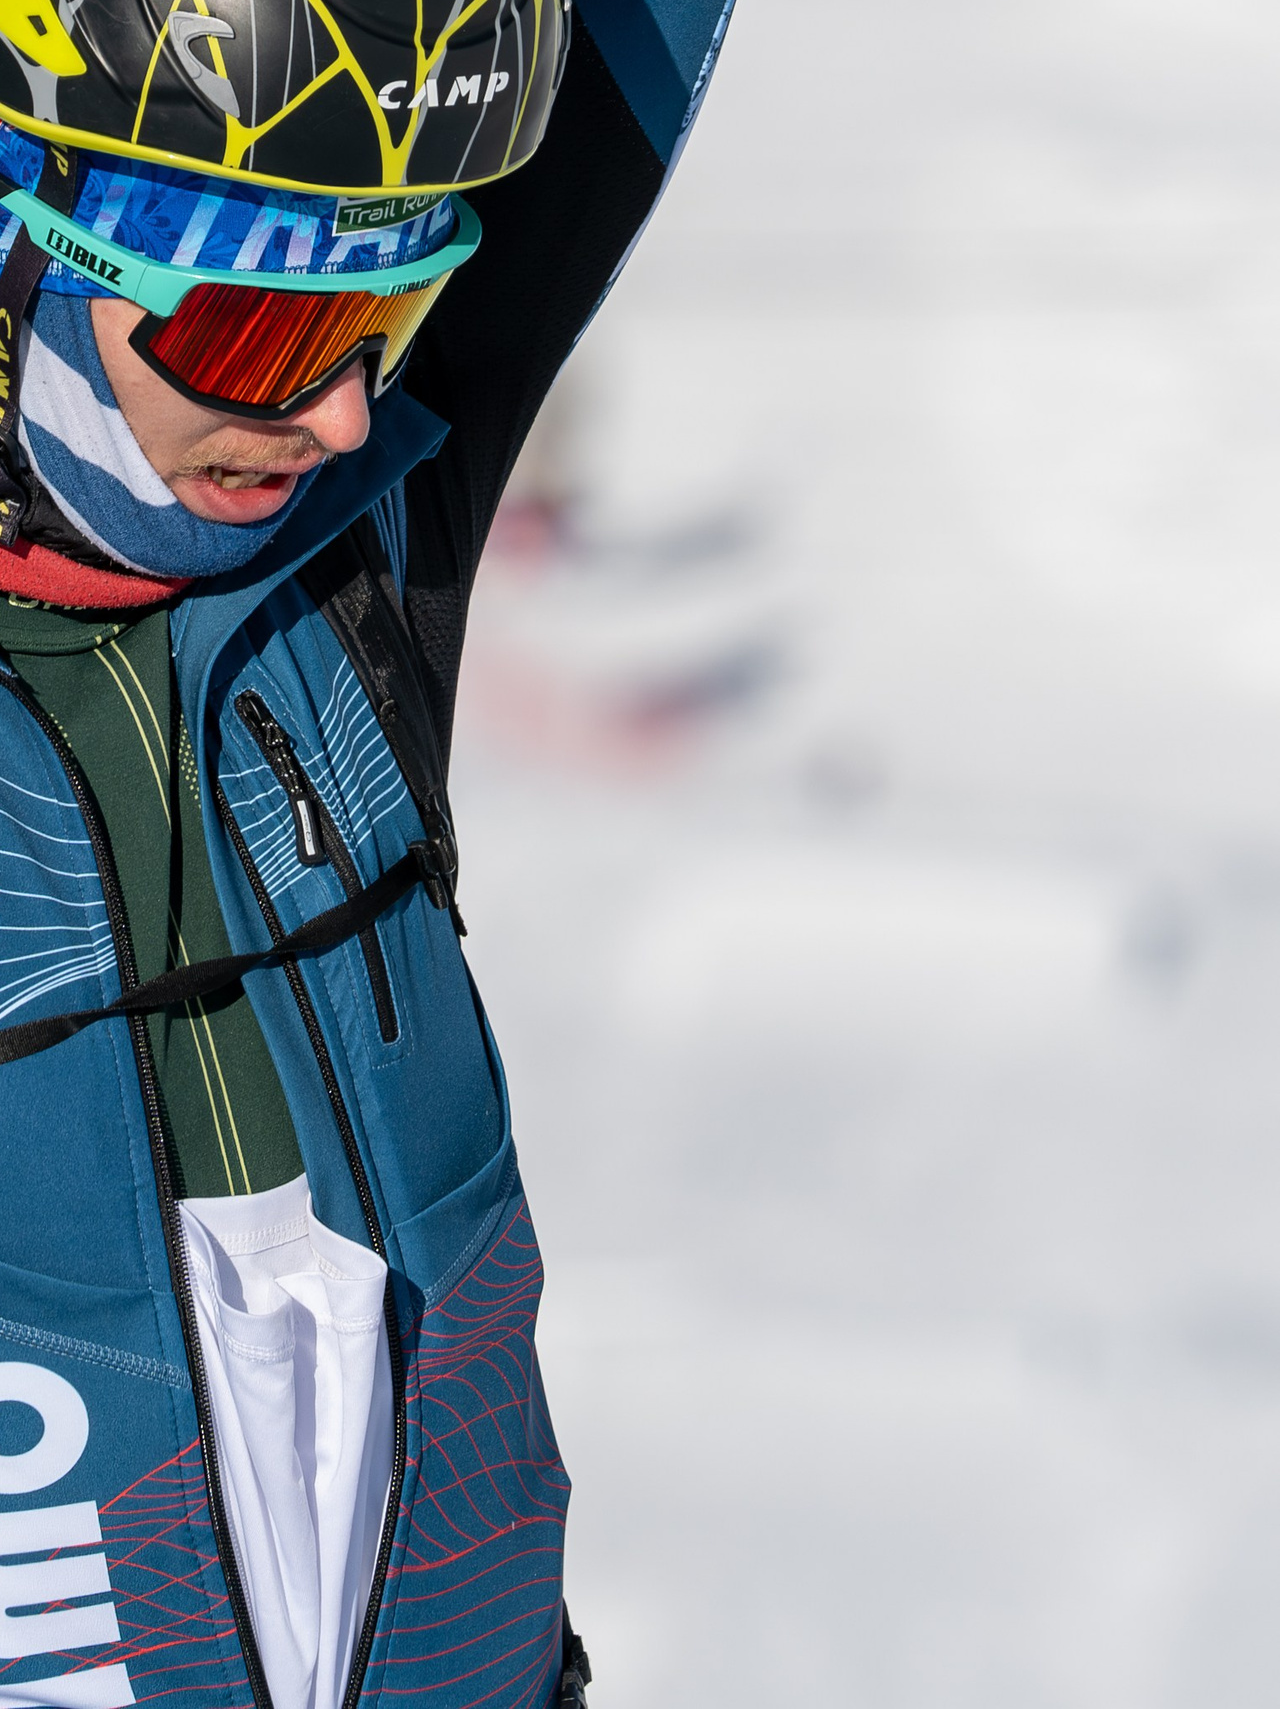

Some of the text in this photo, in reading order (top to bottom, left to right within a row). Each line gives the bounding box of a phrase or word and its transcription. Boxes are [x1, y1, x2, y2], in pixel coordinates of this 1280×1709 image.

[377, 71, 510, 110] CAMP
[344, 200, 396, 225] Trail
[71, 243, 125, 287] BLIZ
